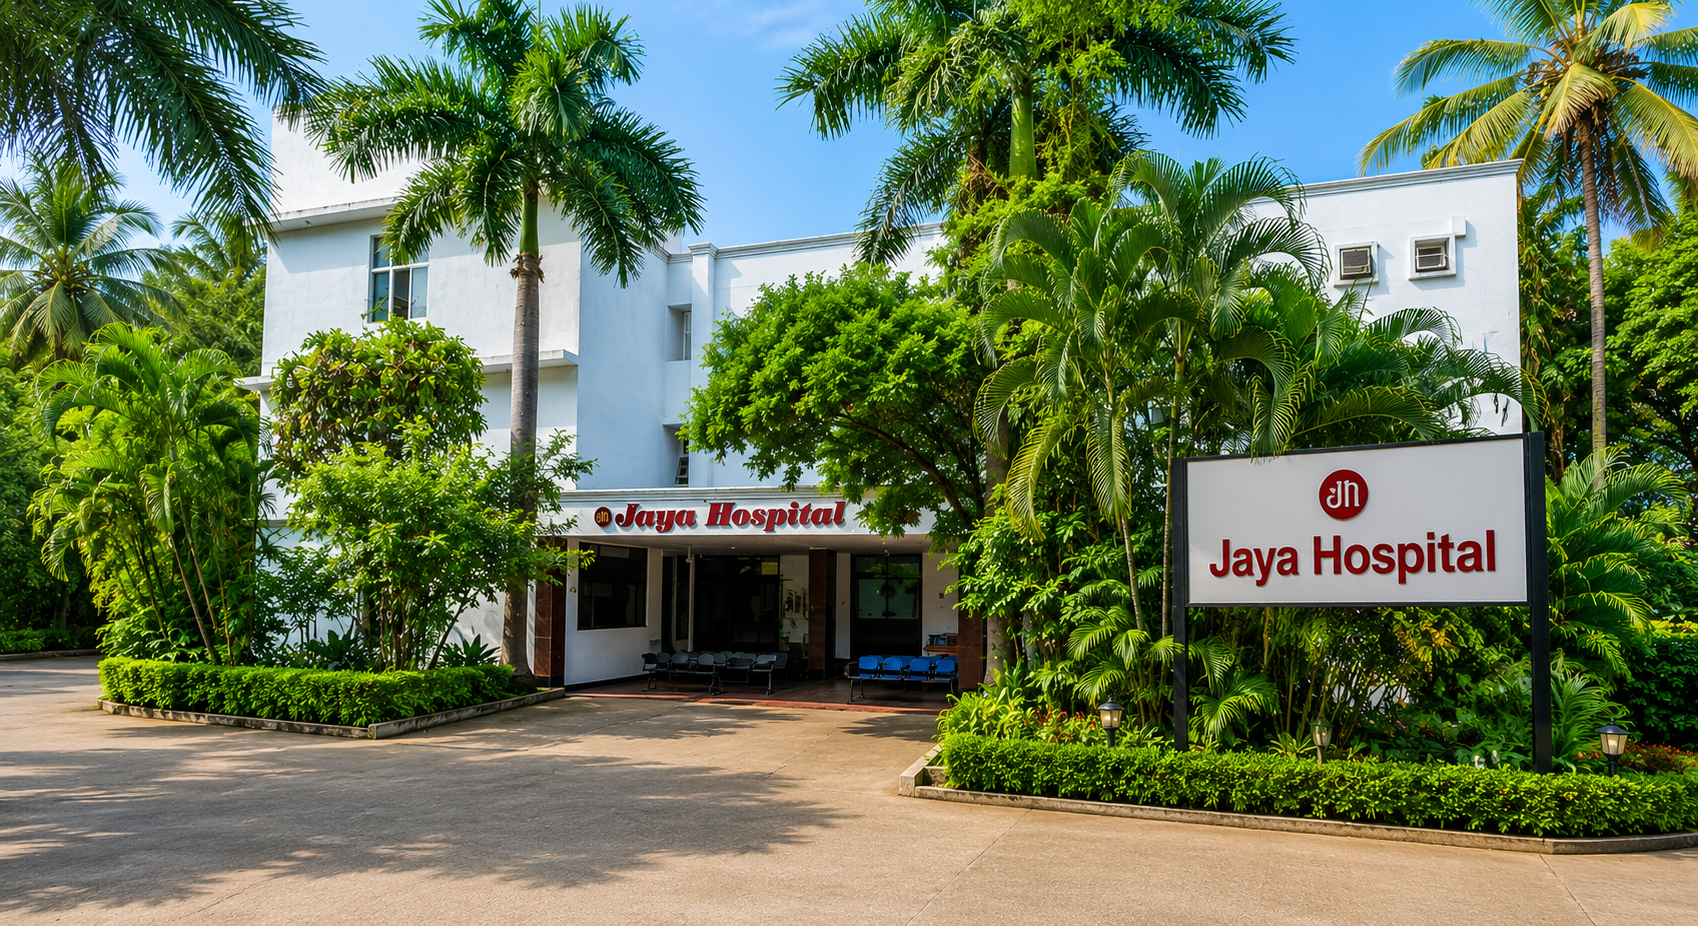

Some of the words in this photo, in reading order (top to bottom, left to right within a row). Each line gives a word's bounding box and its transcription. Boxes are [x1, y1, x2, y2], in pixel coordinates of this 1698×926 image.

[614, 503, 697, 533] Jaya
[704, 501, 845, 532] Hospital
[1209, 538, 1299, 587] Jaya
[1313, 529, 1496, 584] Hospital
